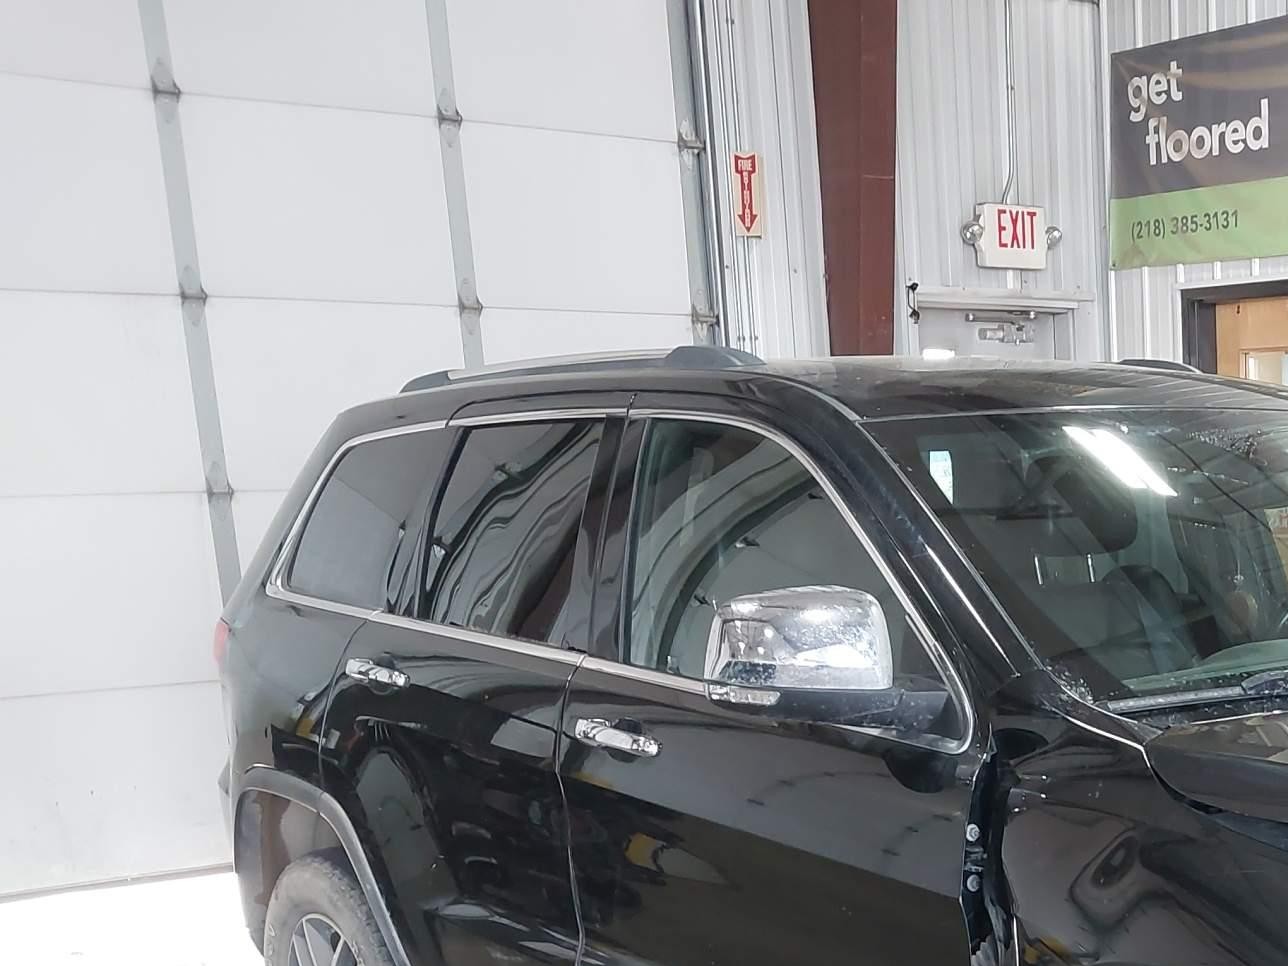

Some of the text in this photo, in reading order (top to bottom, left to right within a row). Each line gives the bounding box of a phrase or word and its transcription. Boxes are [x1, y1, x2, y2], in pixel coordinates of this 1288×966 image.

[1127, 61, 1183, 123] get
[1146, 99, 1269, 165] floored
[997, 208, 1037, 250] EXIT
[1131, 210, 1239, 241] (218) 385-3131
